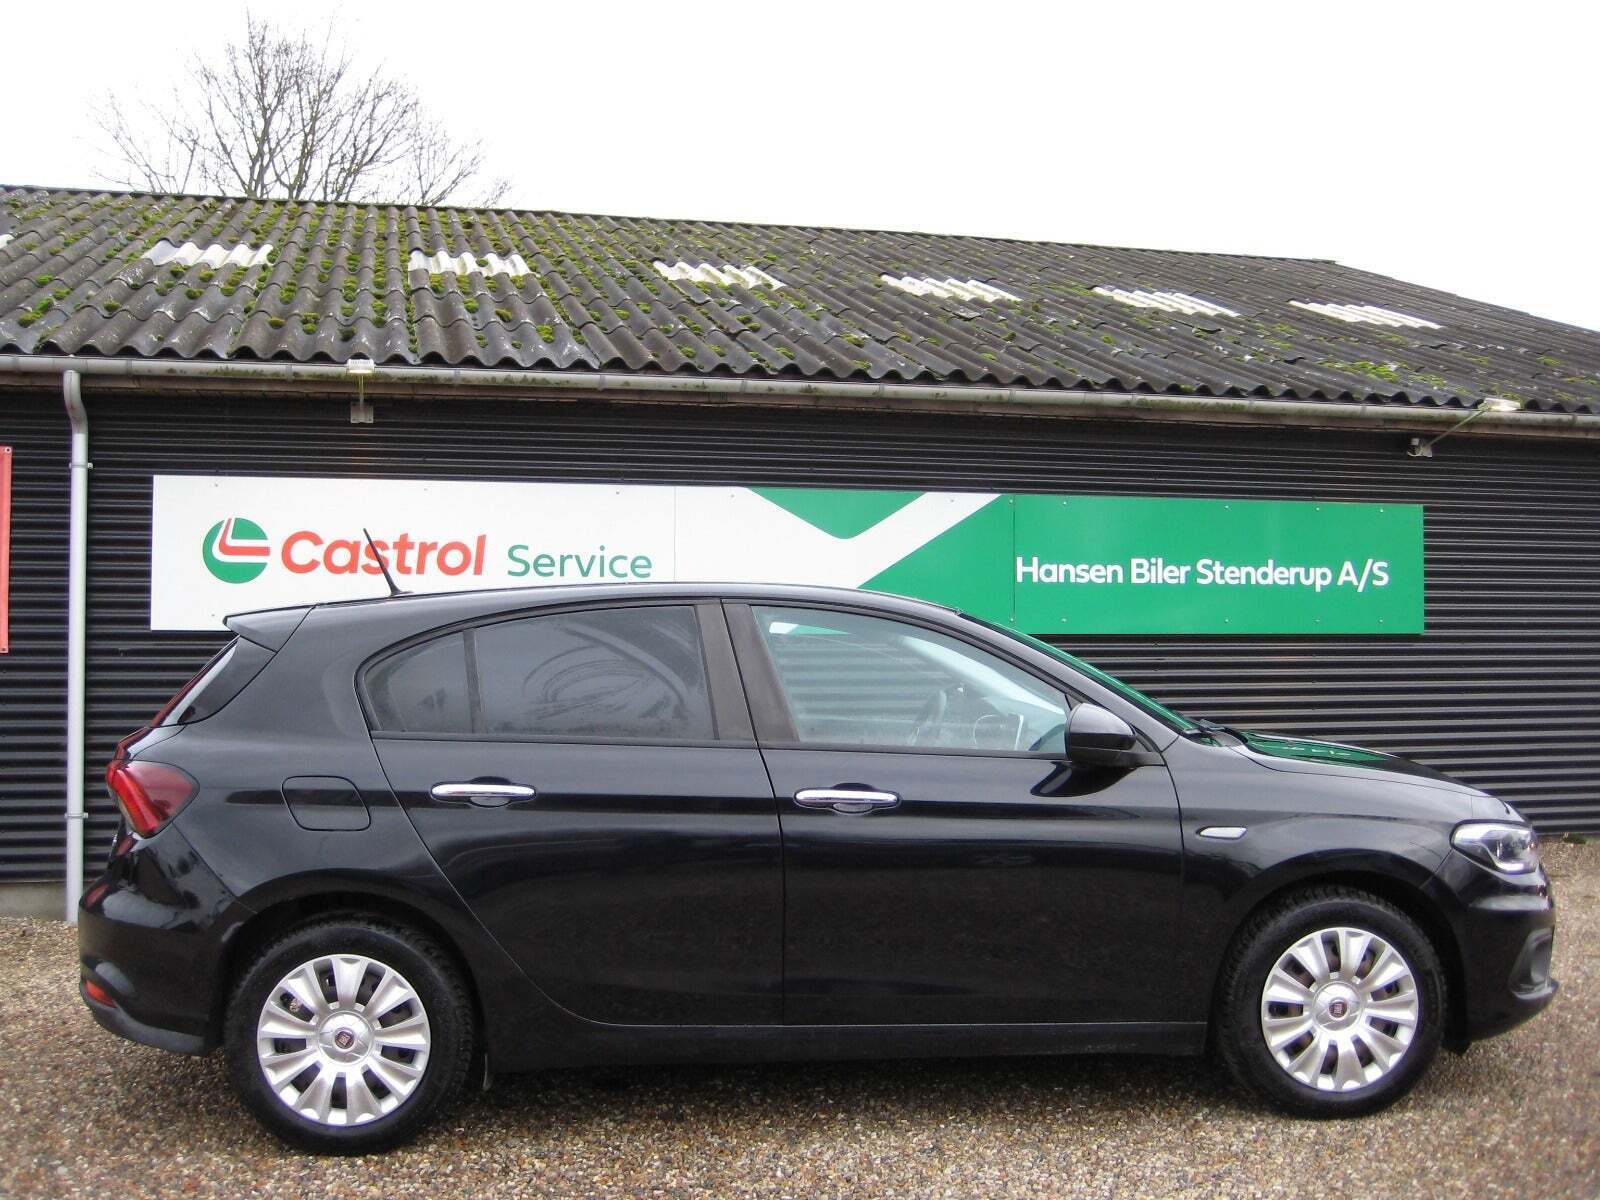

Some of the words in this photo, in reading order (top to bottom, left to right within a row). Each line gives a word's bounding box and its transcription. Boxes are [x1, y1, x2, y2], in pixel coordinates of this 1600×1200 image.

[281, 529, 487, 576] Castrol
[507, 543, 652, 578] Service
[1015, 556, 1123, 584] Hansen
[1130, 557, 1191, 585] Biler
[1195, 557, 1333, 592] Stenderup
[1337, 558, 1390, 593] A/S
